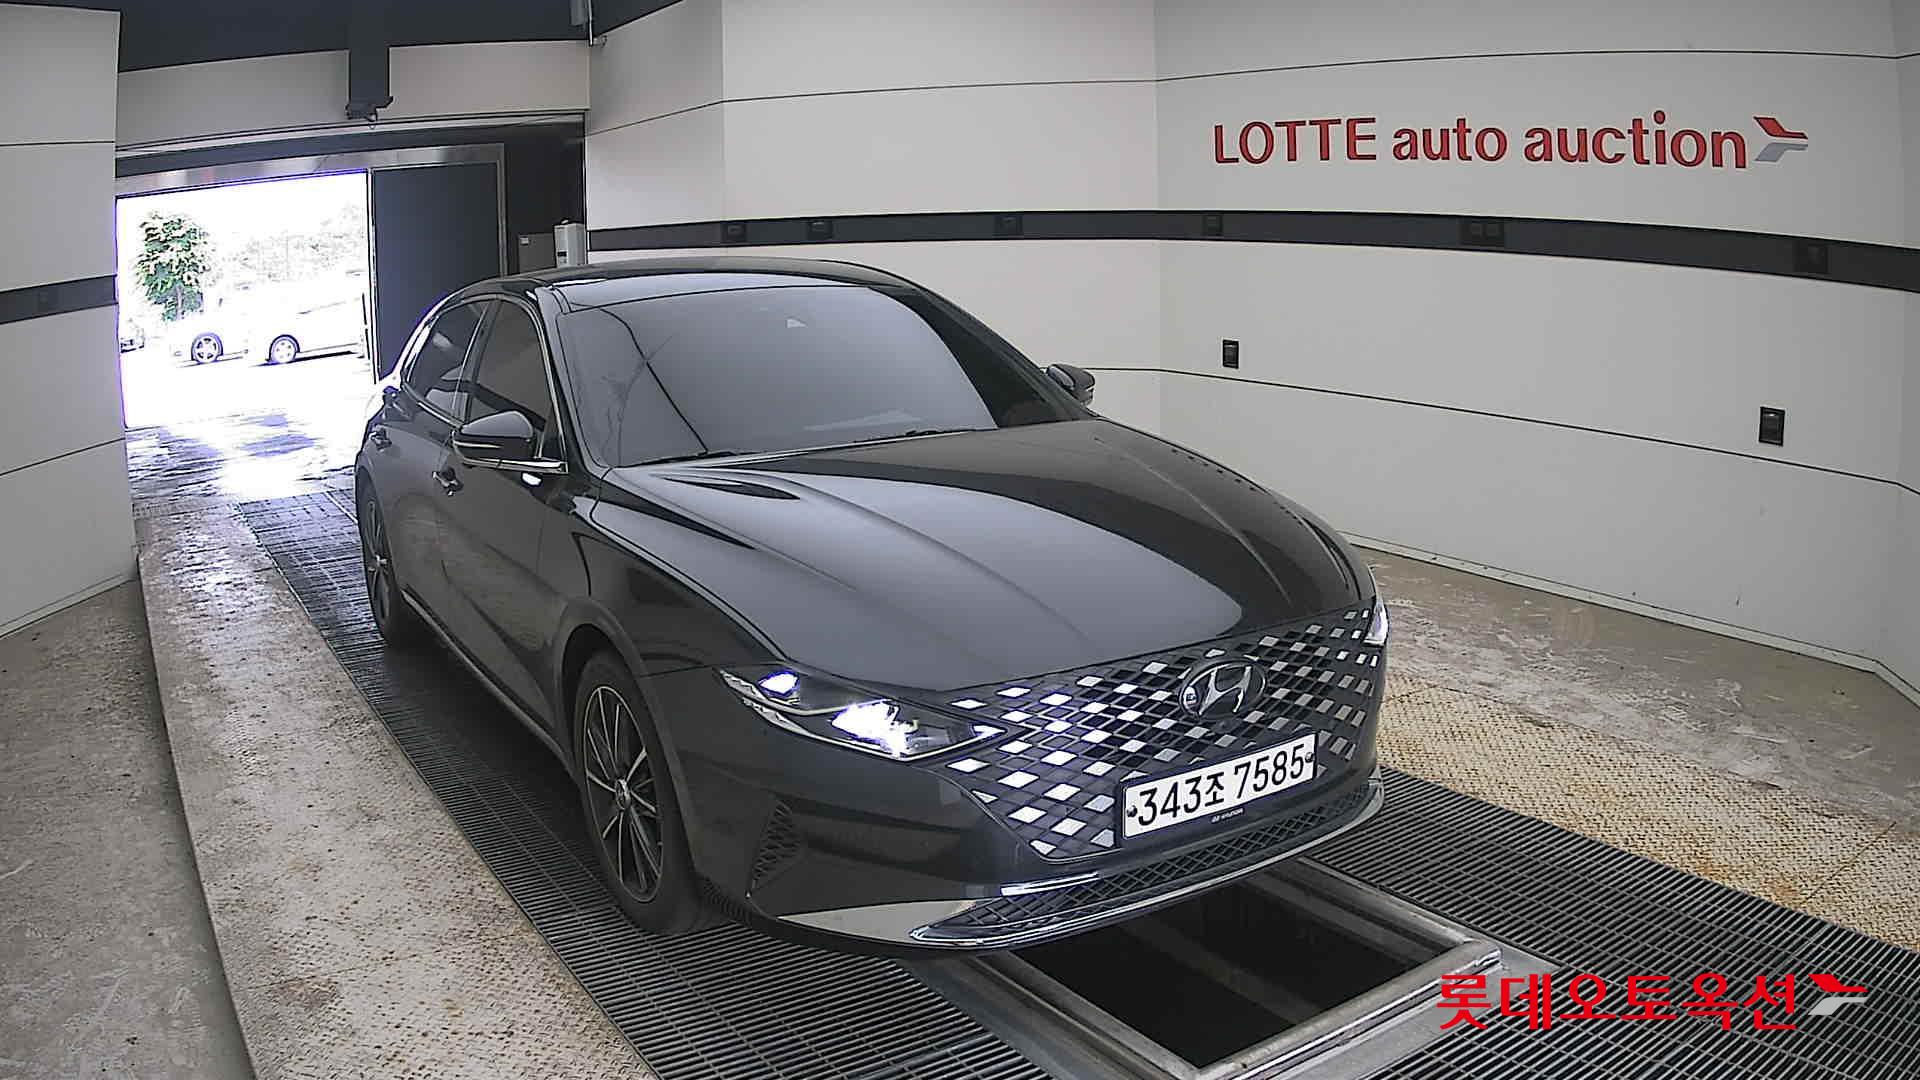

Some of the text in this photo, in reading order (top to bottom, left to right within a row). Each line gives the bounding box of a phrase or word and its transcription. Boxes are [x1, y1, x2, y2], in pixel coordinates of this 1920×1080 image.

[1214, 110, 1746, 168] LOTTE auto auction
[1138, 744, 1304, 825] 343조 7585
